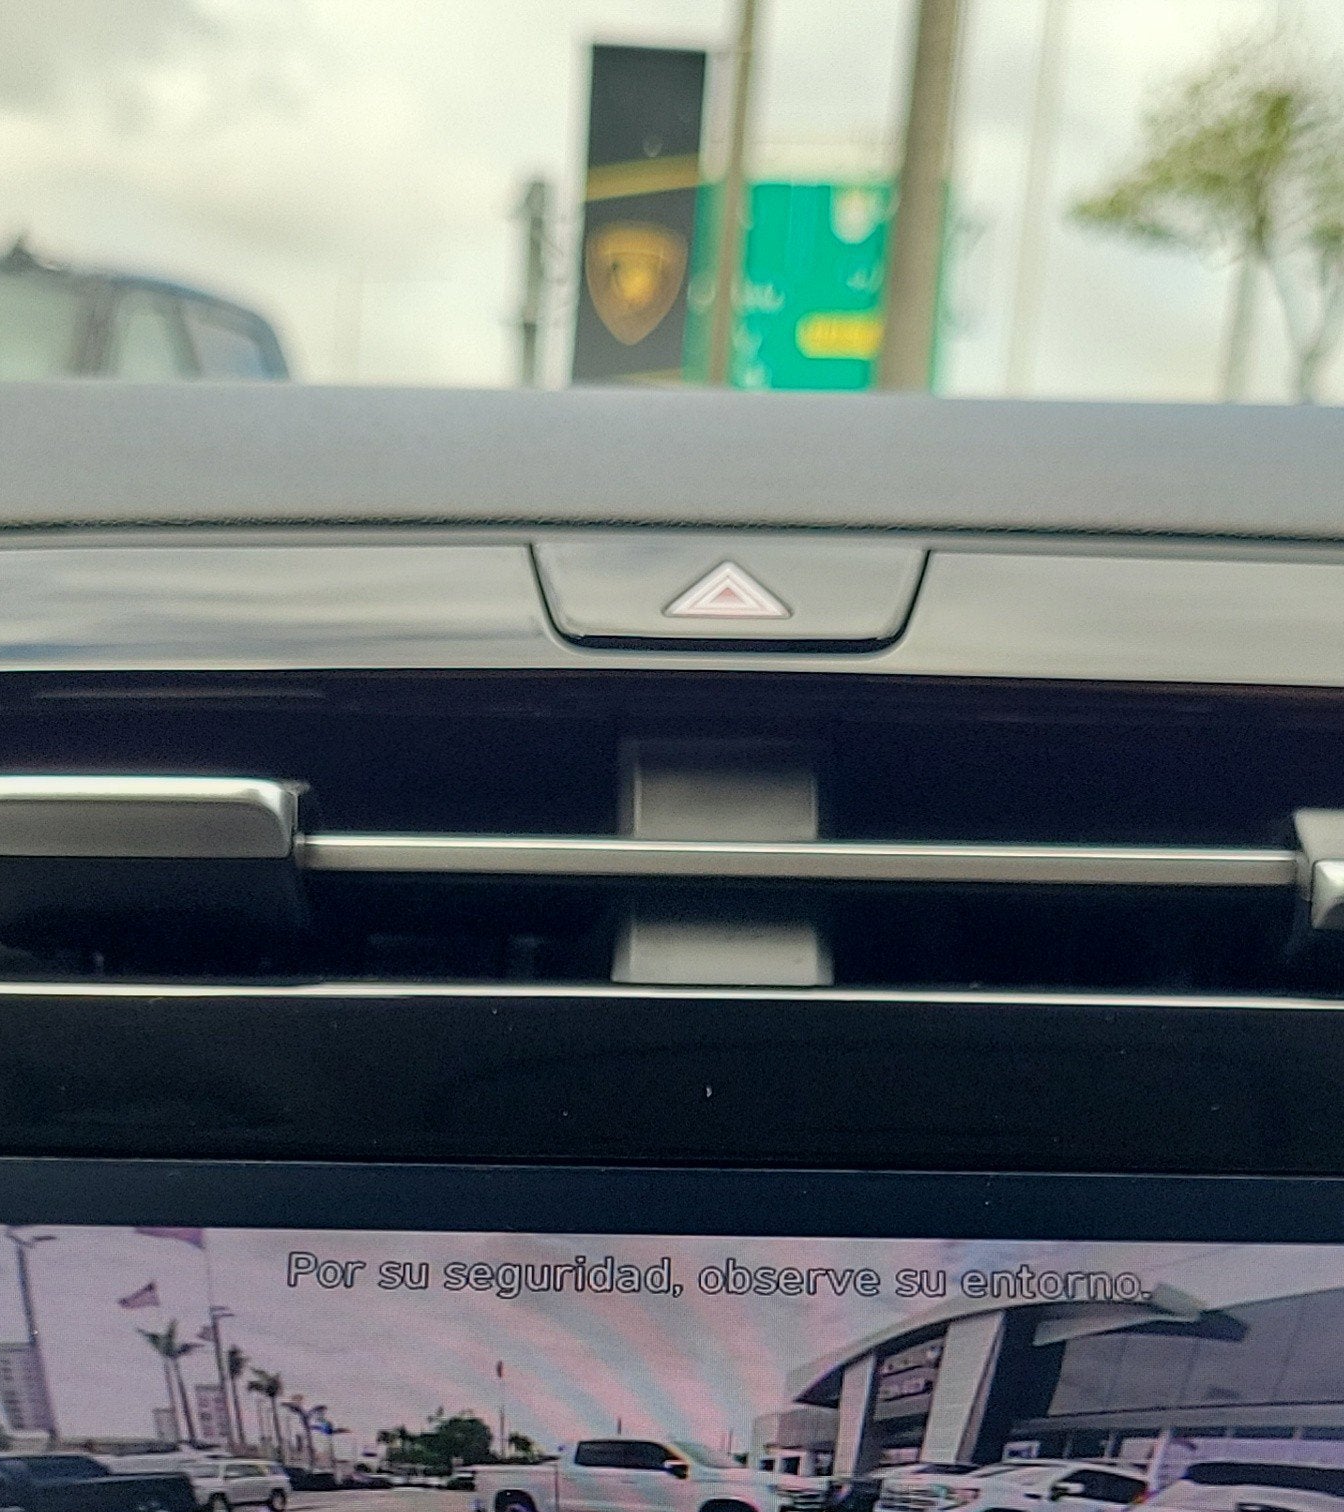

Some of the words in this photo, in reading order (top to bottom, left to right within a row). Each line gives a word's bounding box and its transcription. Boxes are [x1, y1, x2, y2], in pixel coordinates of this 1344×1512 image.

[286, 1251, 366, 1289] Por
[377, 1260, 430, 1290] su
[443, 1254, 684, 1299] seguridad,
[697, 1257, 881, 1297] observe
[894, 1267, 947, 1298] su
[960, 1264, 1154, 1301] entorno.
